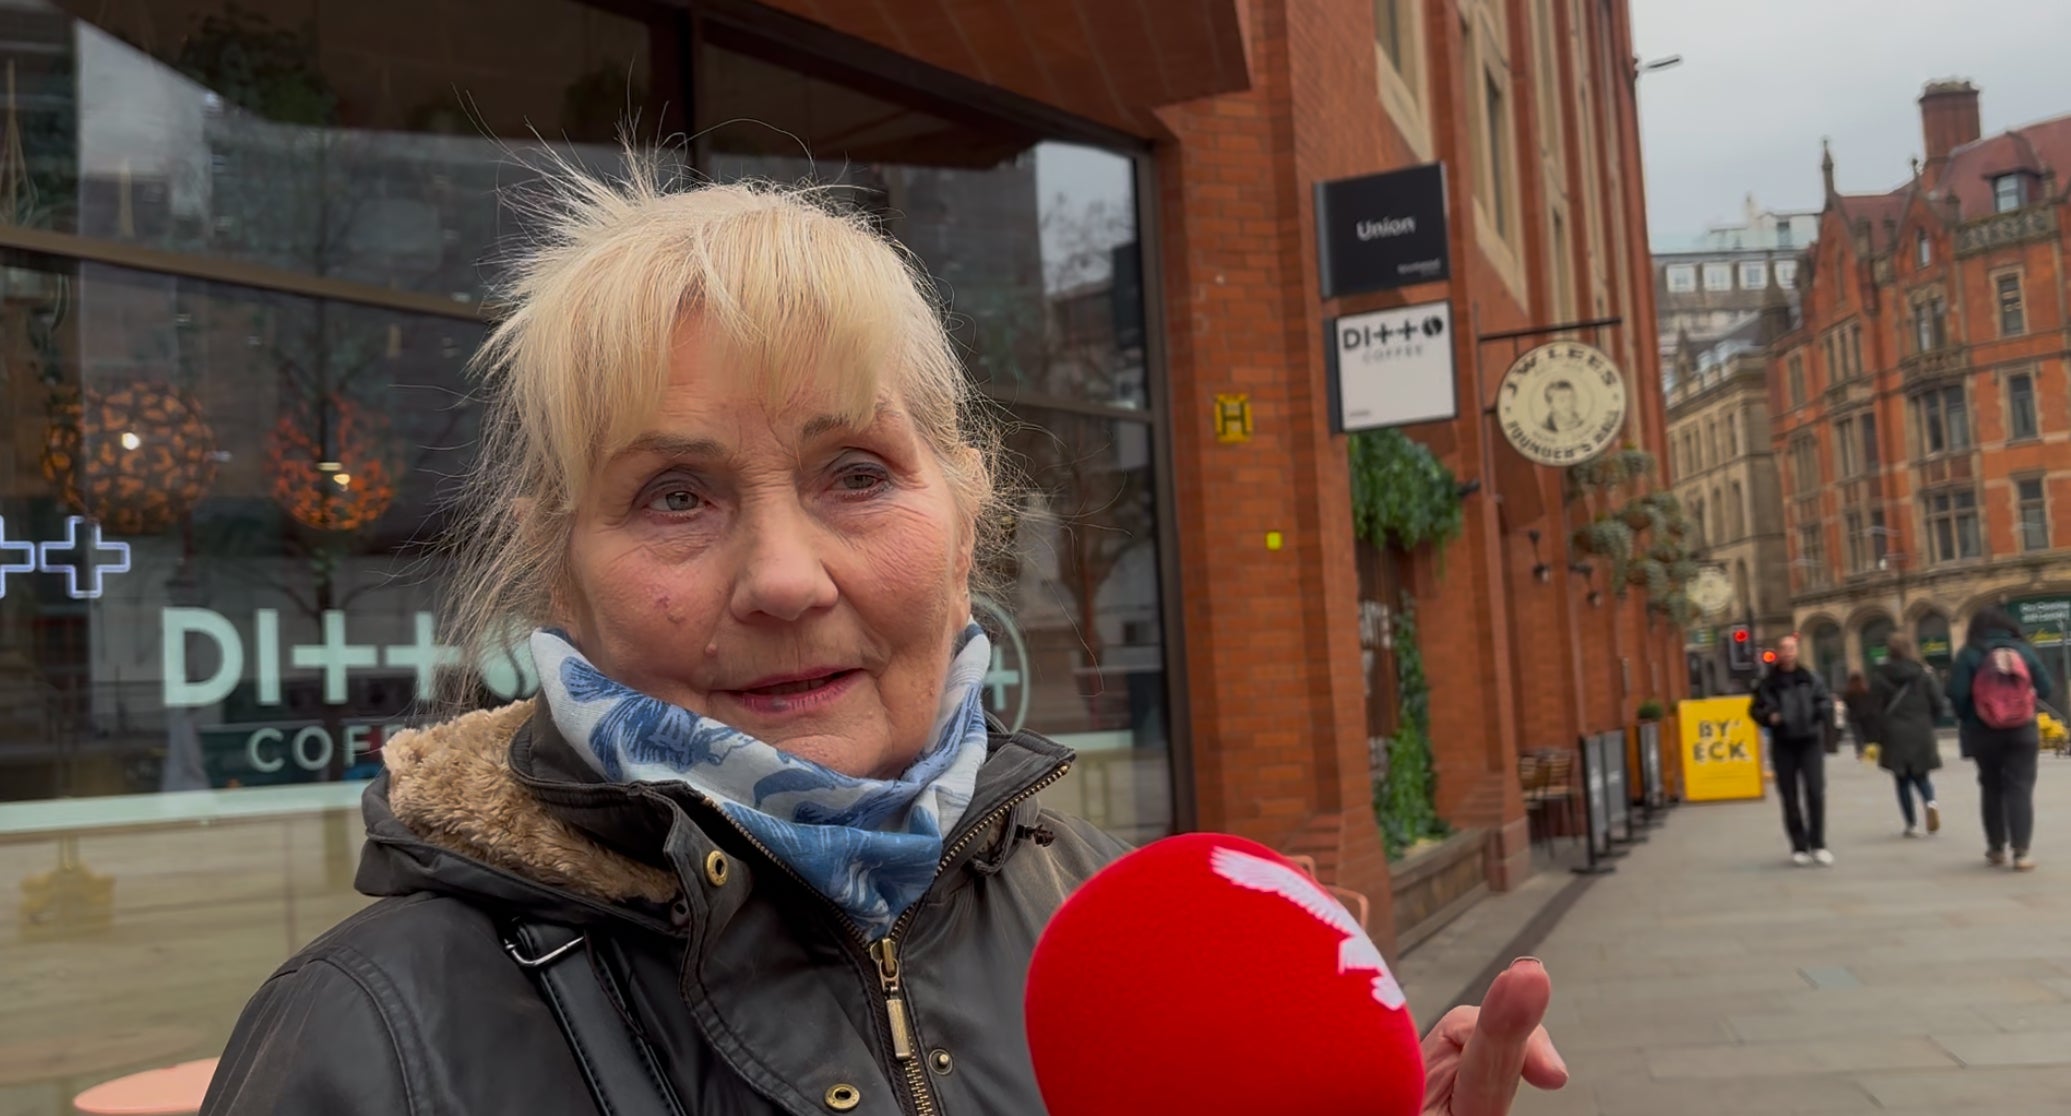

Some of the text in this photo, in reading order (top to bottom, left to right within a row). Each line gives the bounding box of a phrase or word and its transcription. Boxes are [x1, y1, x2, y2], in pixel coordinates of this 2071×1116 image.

[1356, 216, 1416, 241] Union
[1548, 348, 1617, 386] LEES
[1221, 402, 1247, 435] H
[1693, 740, 1747, 762] ECK
